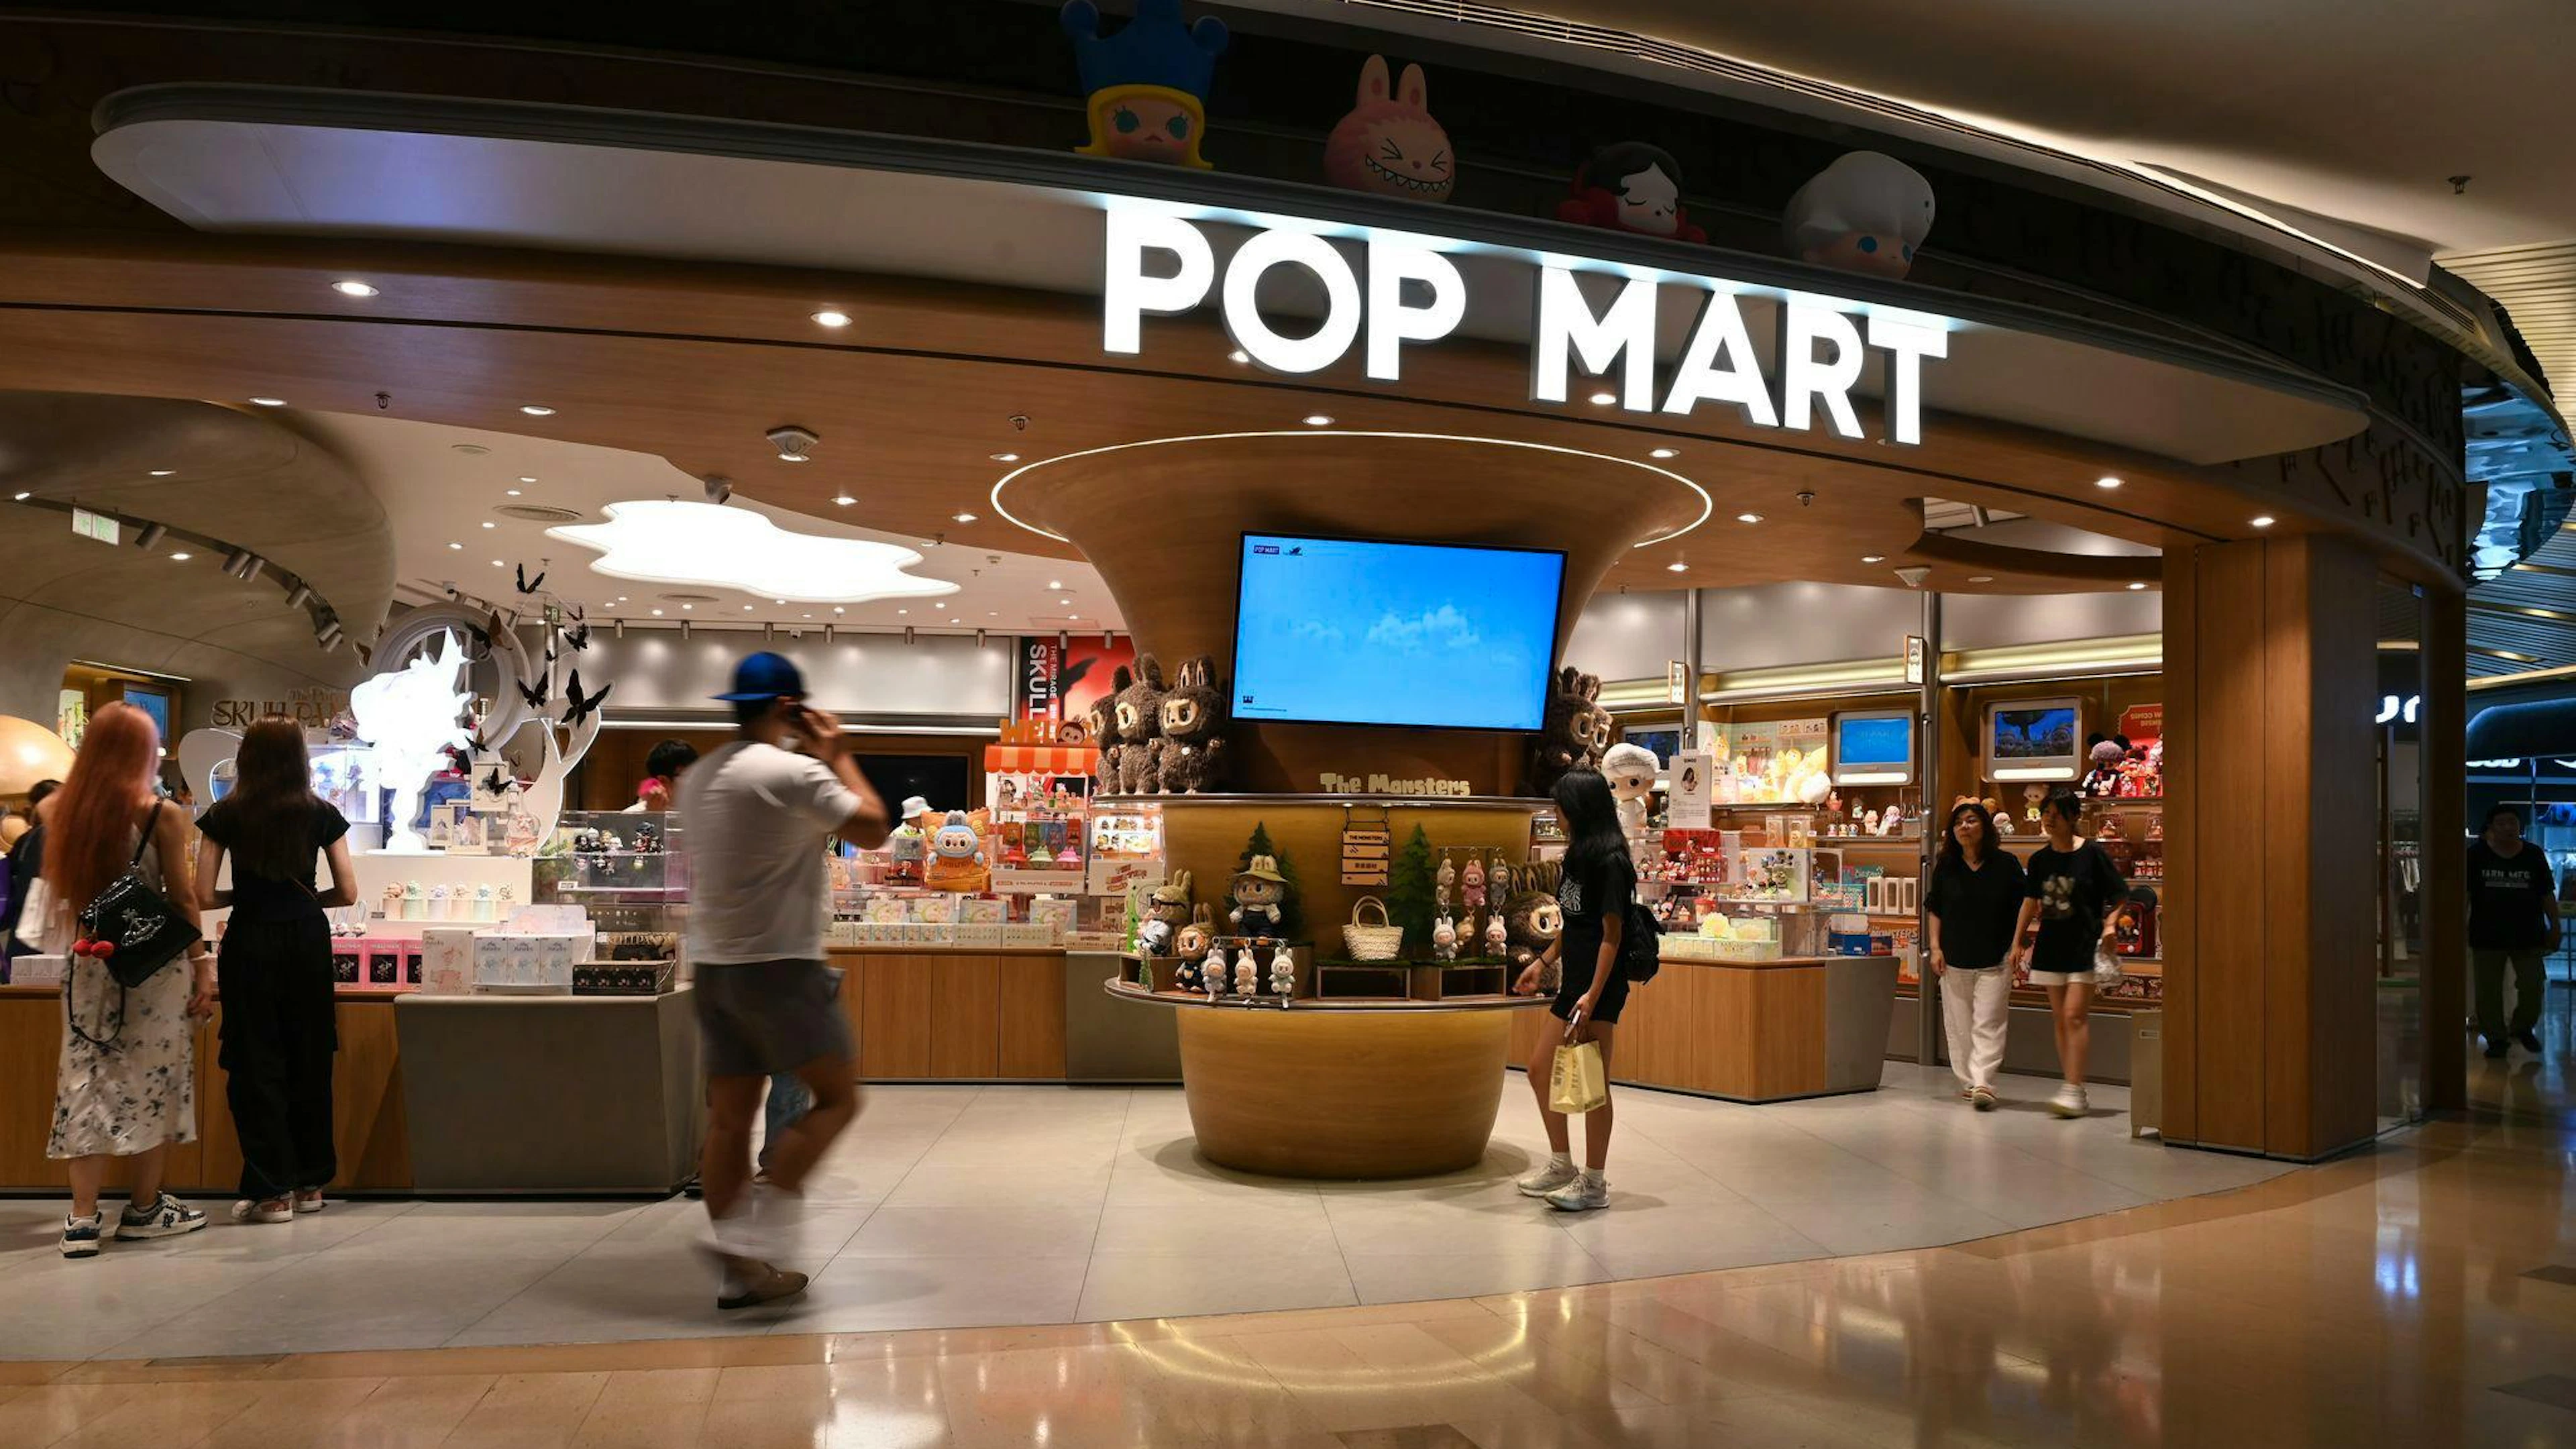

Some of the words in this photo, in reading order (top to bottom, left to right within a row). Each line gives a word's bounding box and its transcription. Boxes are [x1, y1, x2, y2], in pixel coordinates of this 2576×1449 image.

[1104, 203, 1466, 381] POP
[1532, 262, 1949, 445] MART
[1320, 773, 1362, 793] The
[1368, 773, 1470, 796] Monsters
